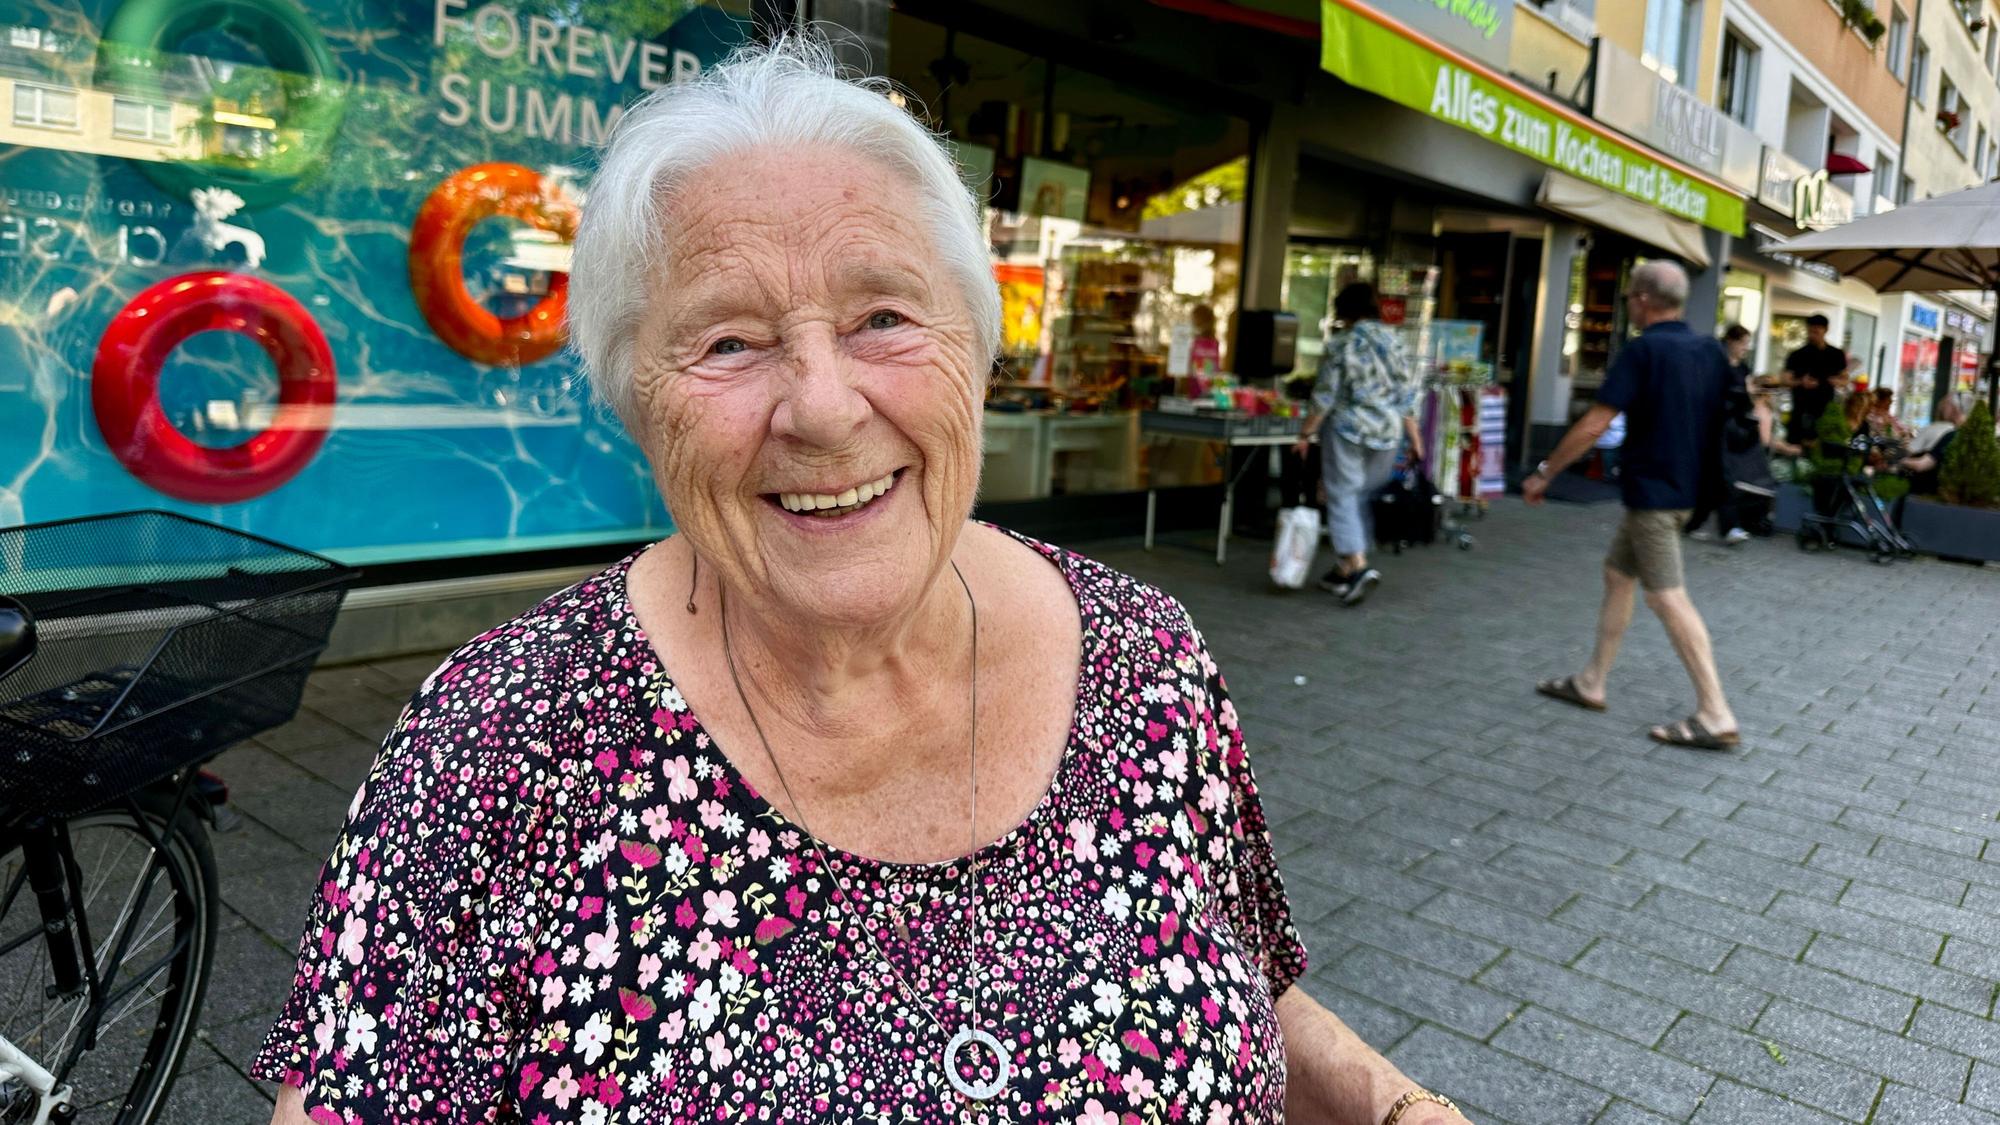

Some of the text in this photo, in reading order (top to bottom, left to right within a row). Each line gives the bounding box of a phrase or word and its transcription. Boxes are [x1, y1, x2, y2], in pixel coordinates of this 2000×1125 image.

[433, 0, 701, 91] FOREVER
[1430, 64, 1498, 135] Alles
[1501, 105, 1551, 158] zum
[1554, 120, 1623, 188] Kochen
[1624, 163, 1658, 201] und
[1658, 167, 1708, 222] Backen
